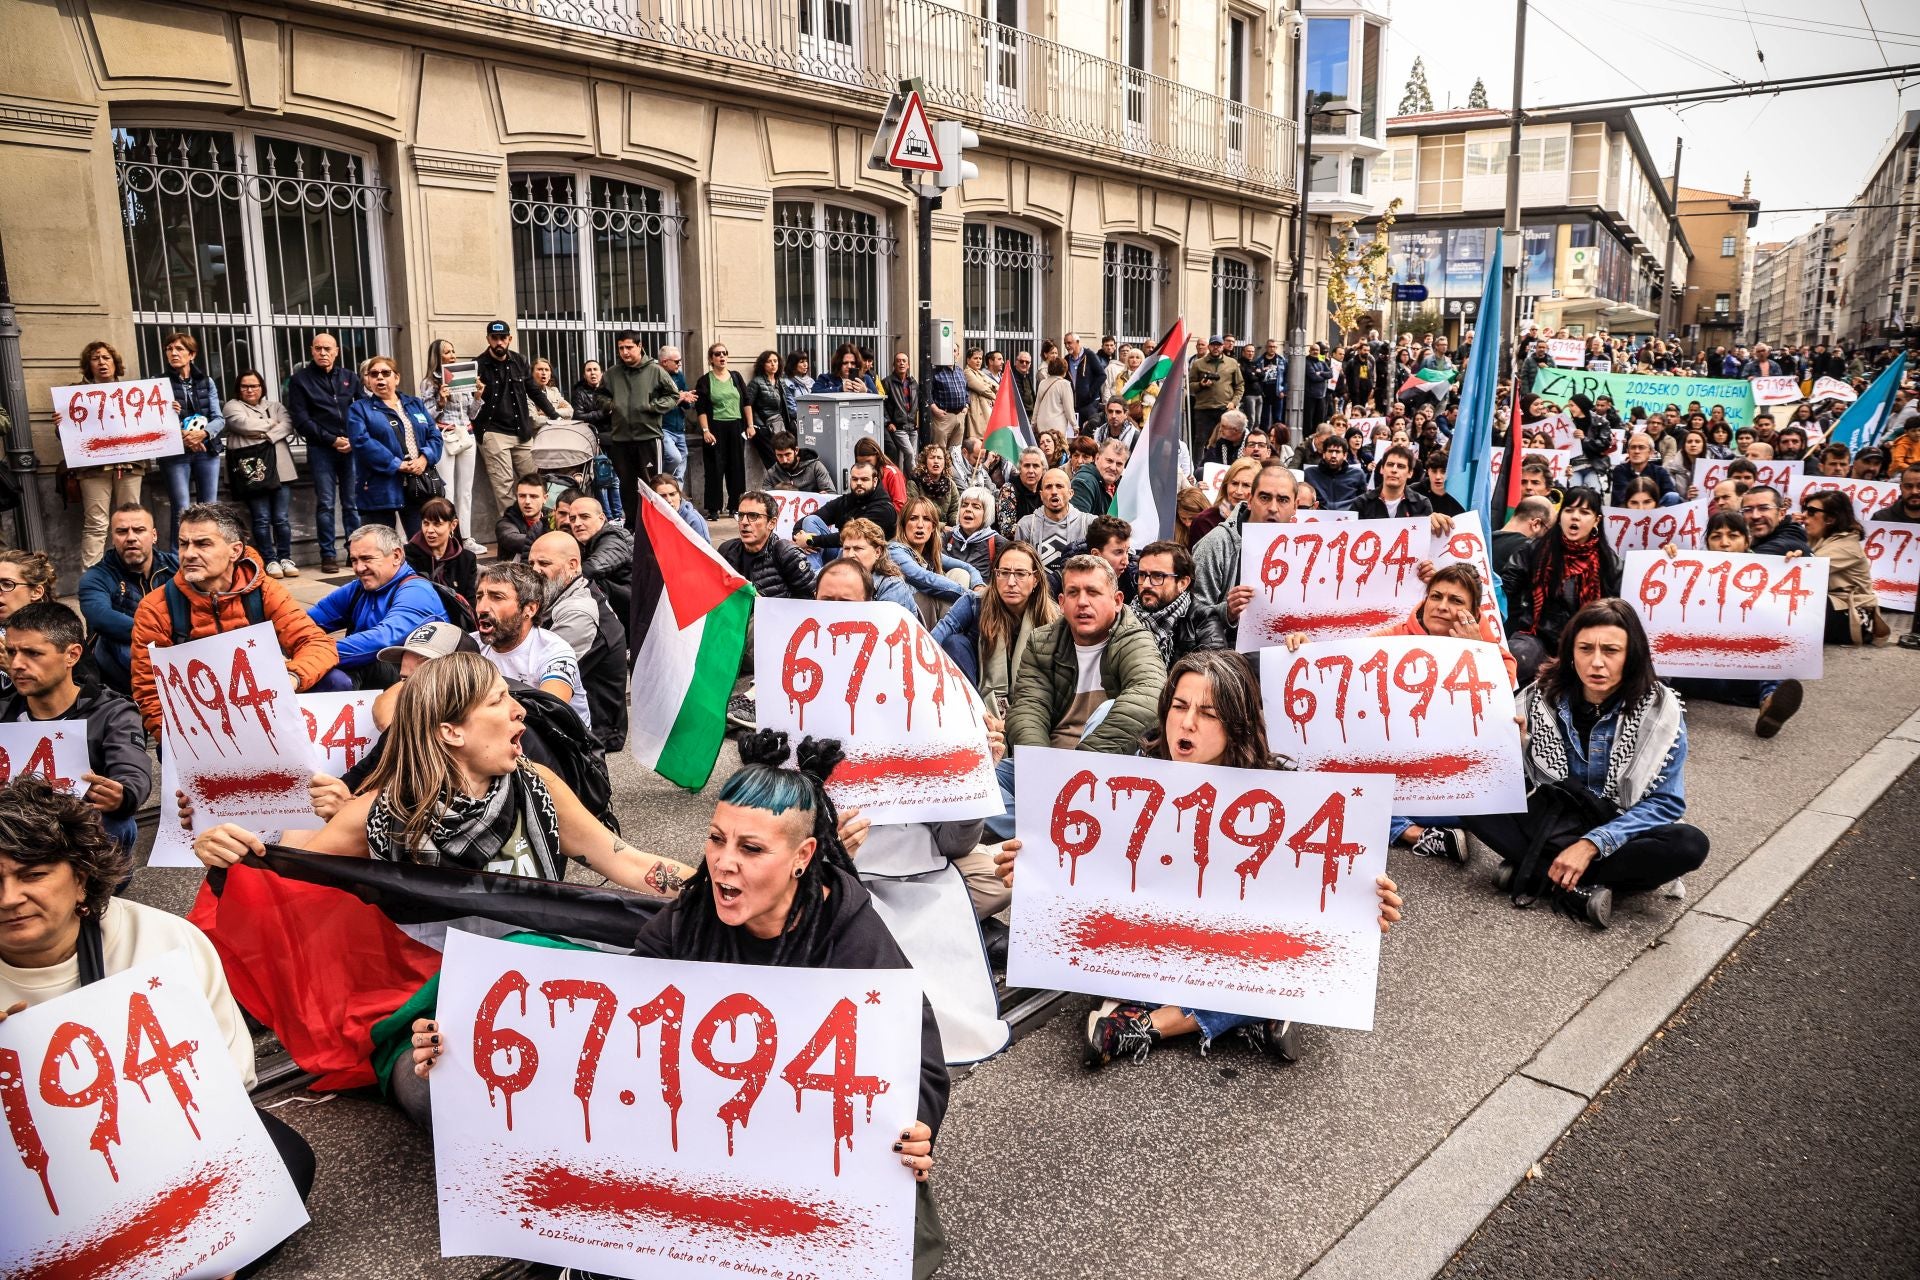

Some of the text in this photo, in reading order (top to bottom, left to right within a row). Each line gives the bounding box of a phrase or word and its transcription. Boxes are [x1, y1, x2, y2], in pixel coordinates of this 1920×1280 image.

[1626, 381, 1748, 398] 2025EKO OTSAILEAN
[1083, 963, 1120, 976] 2025eko
[1121, 970, 1151, 979] urriaren
[1160, 974, 1176, 983] arte
[1184, 974, 1205, 987] hasta
[1207, 978, 1216, 987] el
[1225, 981, 1235, 990] de
[1267, 986, 1276, 995] de
[1278, 988, 1305, 998] 2025
[197, 1253, 207, 1266] de
[210, 1231, 236, 1256] 2025
[538, 1226, 585, 1244] 2025eko
[587, 1236, 625, 1251] urriaren
[626, 1241, 634, 1250] 9
[635, 1245, 656, 1256] arte
[659, 1246, 663, 1257] /
[667, 1247, 693, 1262] hasta
[696, 1251, 708, 1264] el
[709, 1255, 717, 1265] 9
[718, 1257, 731, 1269] de
[771, 1268, 783, 1280] de
